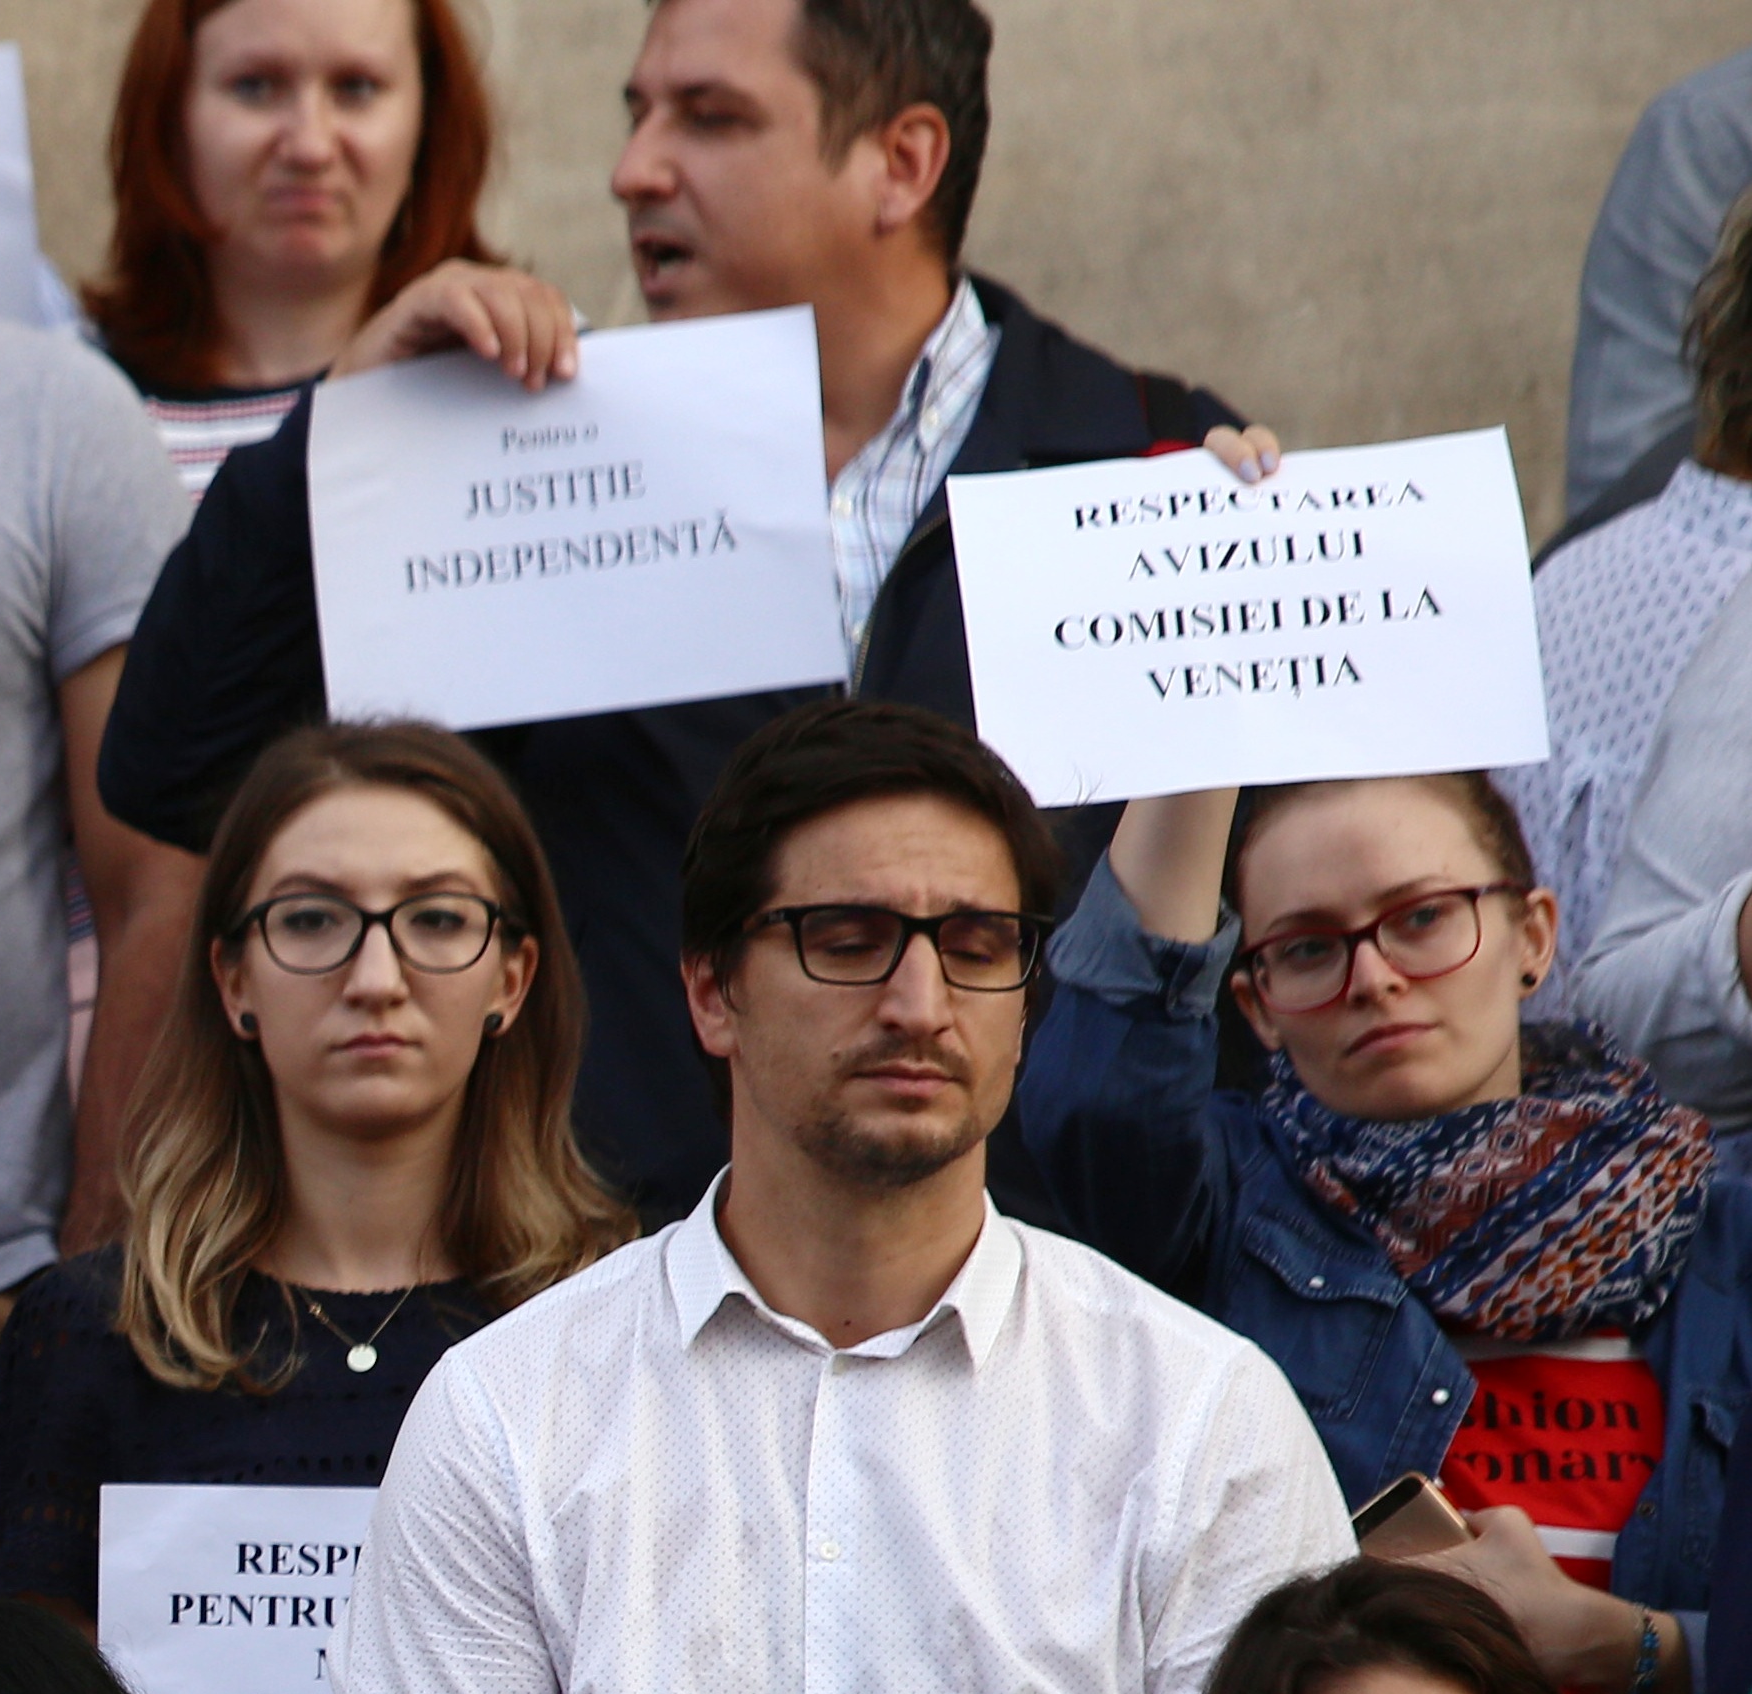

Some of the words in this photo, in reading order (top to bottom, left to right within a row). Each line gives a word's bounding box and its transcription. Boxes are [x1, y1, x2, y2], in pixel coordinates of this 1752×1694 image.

[500, 425, 577, 455] Pentru
[582, 421, 599, 443] o
[467, 463, 645, 519] JUSTIȚIE
[1075, 478, 1429, 530] RESPECTAREA
[404, 510, 737, 594] INDEPENDENTĂ
[1130, 531, 1363, 578] AVIZULUI
[1055, 600, 1281, 647] COMISIEI
[1302, 594, 1364, 627] DE
[1382, 587, 1441, 620] LA
[1148, 654, 1361, 700] VENEȚIA
